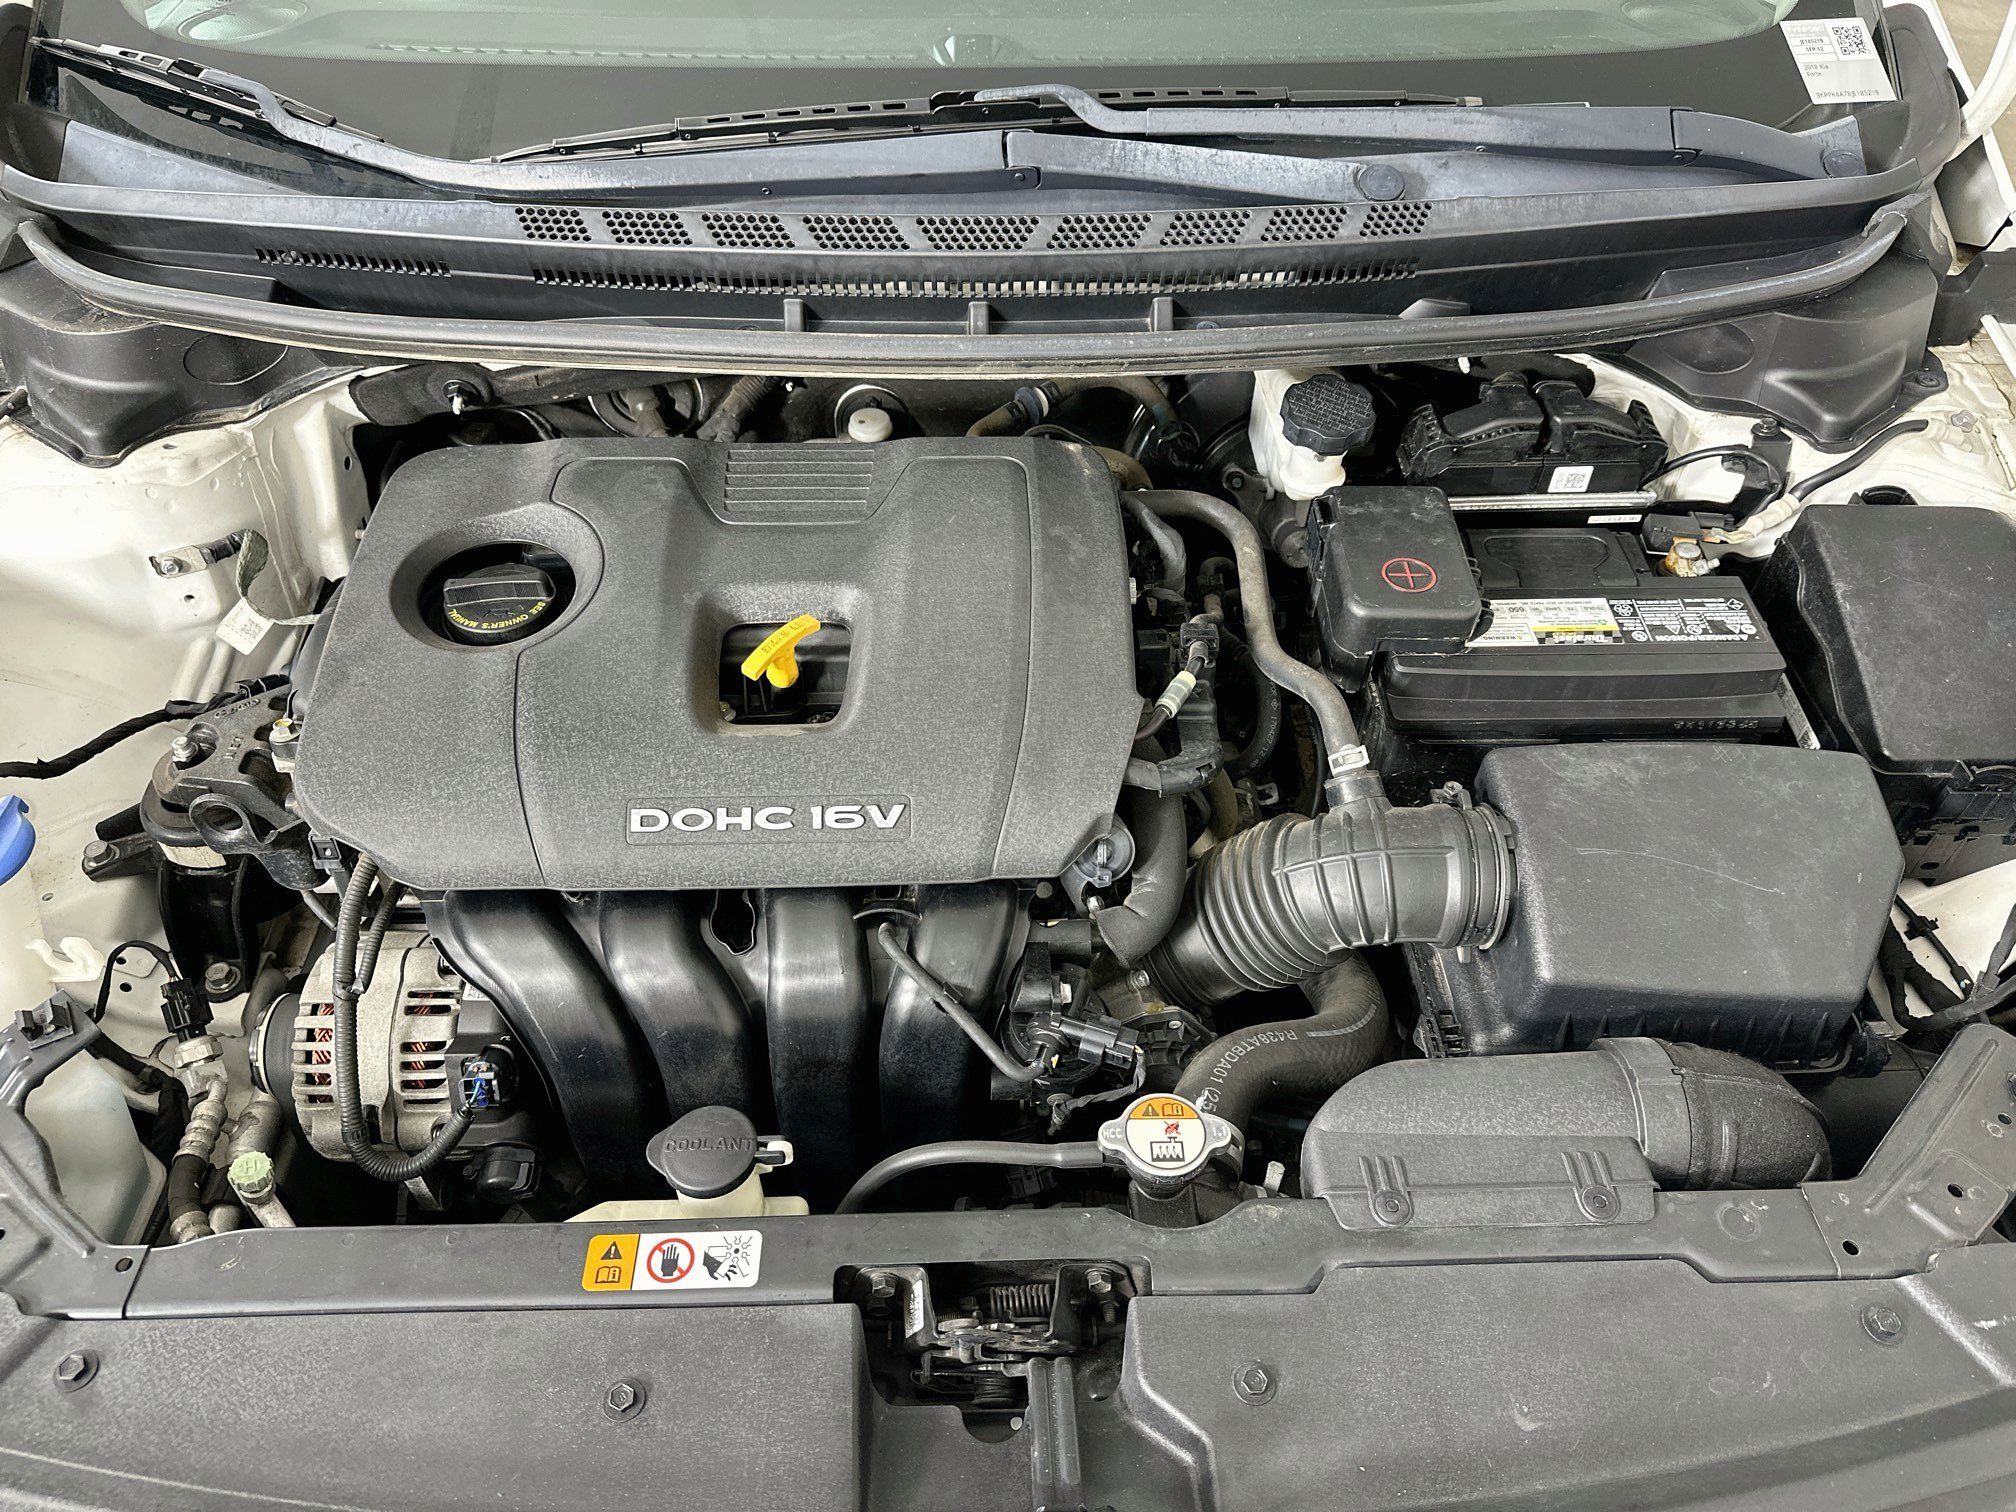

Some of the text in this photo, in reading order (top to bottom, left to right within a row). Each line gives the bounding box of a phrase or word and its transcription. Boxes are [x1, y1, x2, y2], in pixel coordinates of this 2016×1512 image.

[448, 601, 546, 629] SEE OWNER'S MANUAL
[630, 804, 906, 833] DOHC 16V
[1102, 1128, 1123, 1139] HCC
[664, 1137, 755, 1153] COOLANT
